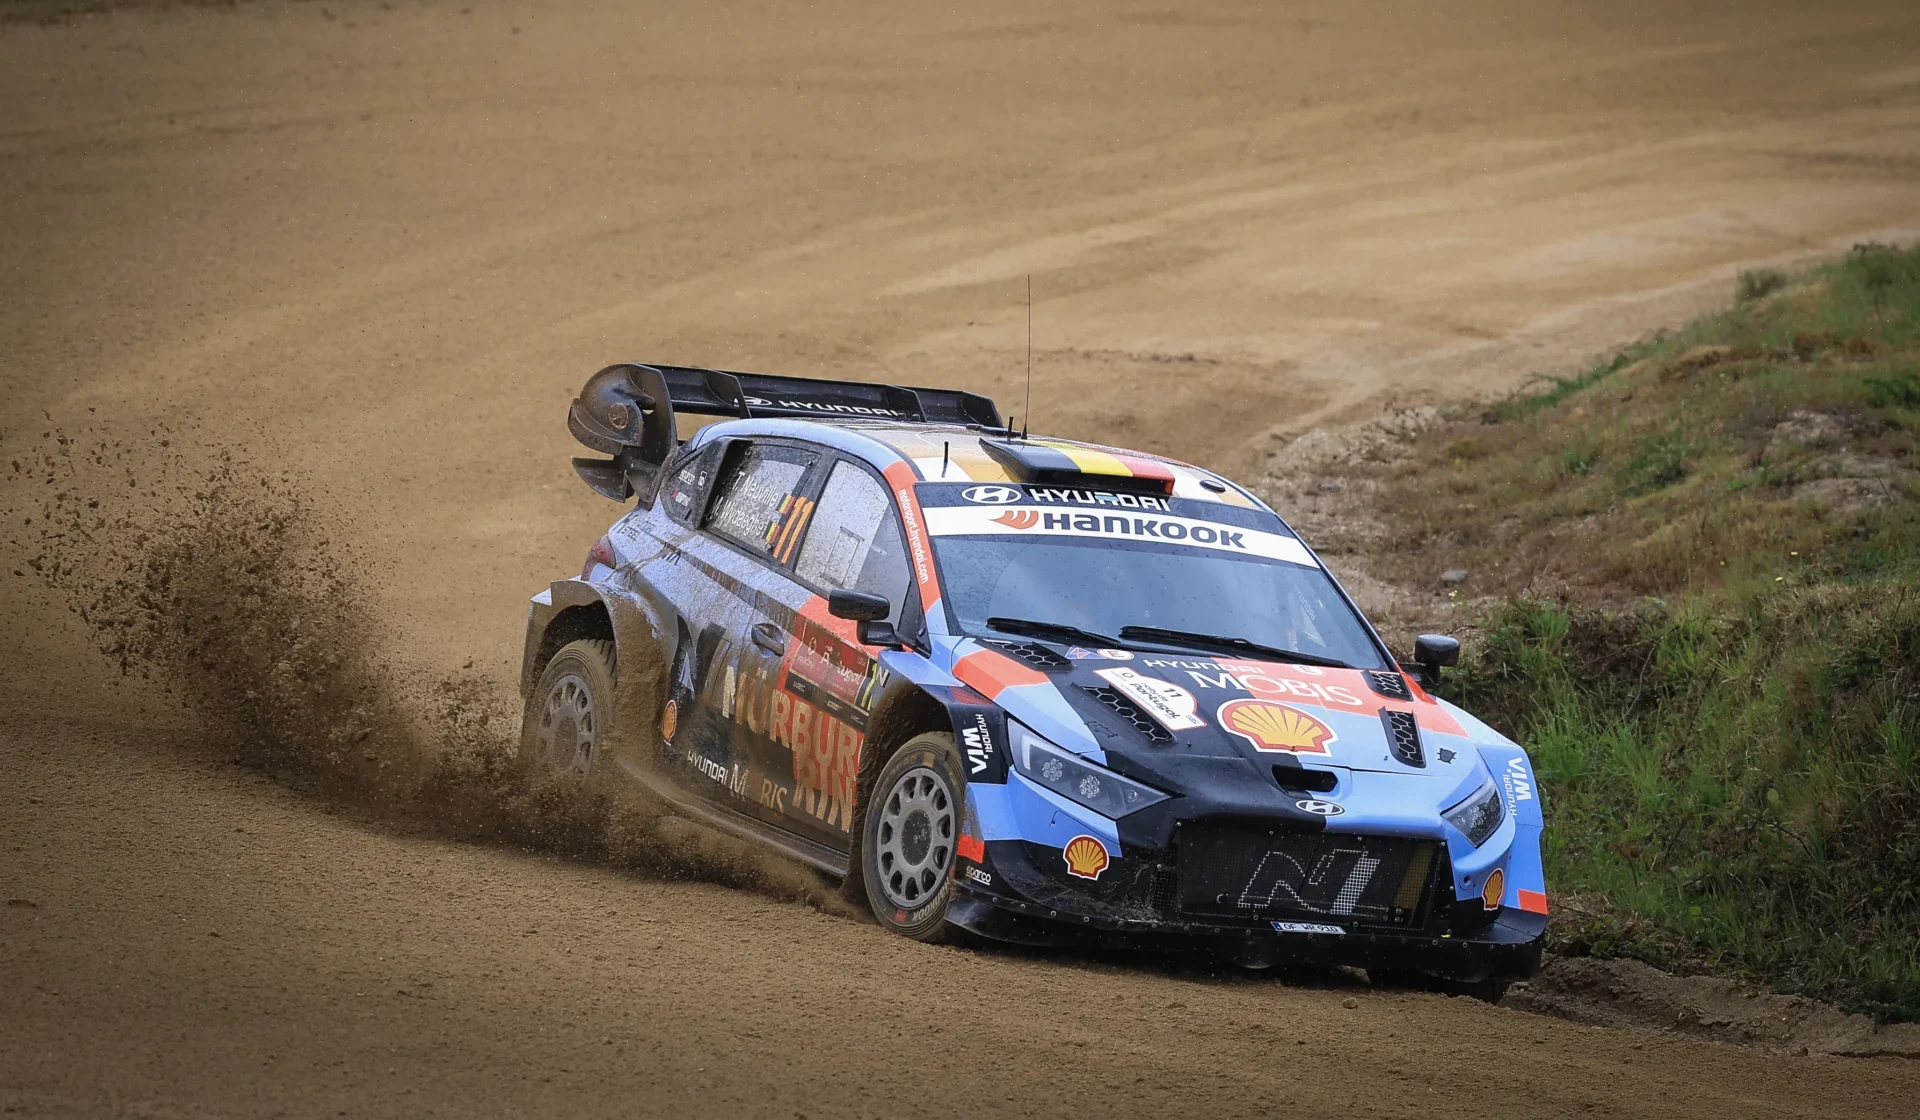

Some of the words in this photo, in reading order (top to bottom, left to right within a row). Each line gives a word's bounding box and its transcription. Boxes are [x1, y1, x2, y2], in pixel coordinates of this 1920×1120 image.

[778, 400, 899, 416] HYUNDAI
[741, 475, 779, 507] Neuville
[1031, 488, 1171, 512] HYUNDAI
[773, 496, 816, 565] 11
[898, 489, 929, 584] motorsport.hyundai.com
[1143, 659, 1265, 675] HYUNDAI
[1129, 683, 1181, 719] Portugal
[1163, 687, 1183, 698] 11
[1182, 669, 1363, 706] MOBIS
[962, 727, 989, 775] WIA
[975, 713, 994, 753] HYUNDAI
[1502, 774, 1518, 816] HYUNDAI
[1507, 757, 1532, 801] WIA
[966, 865, 992, 886] sparco
